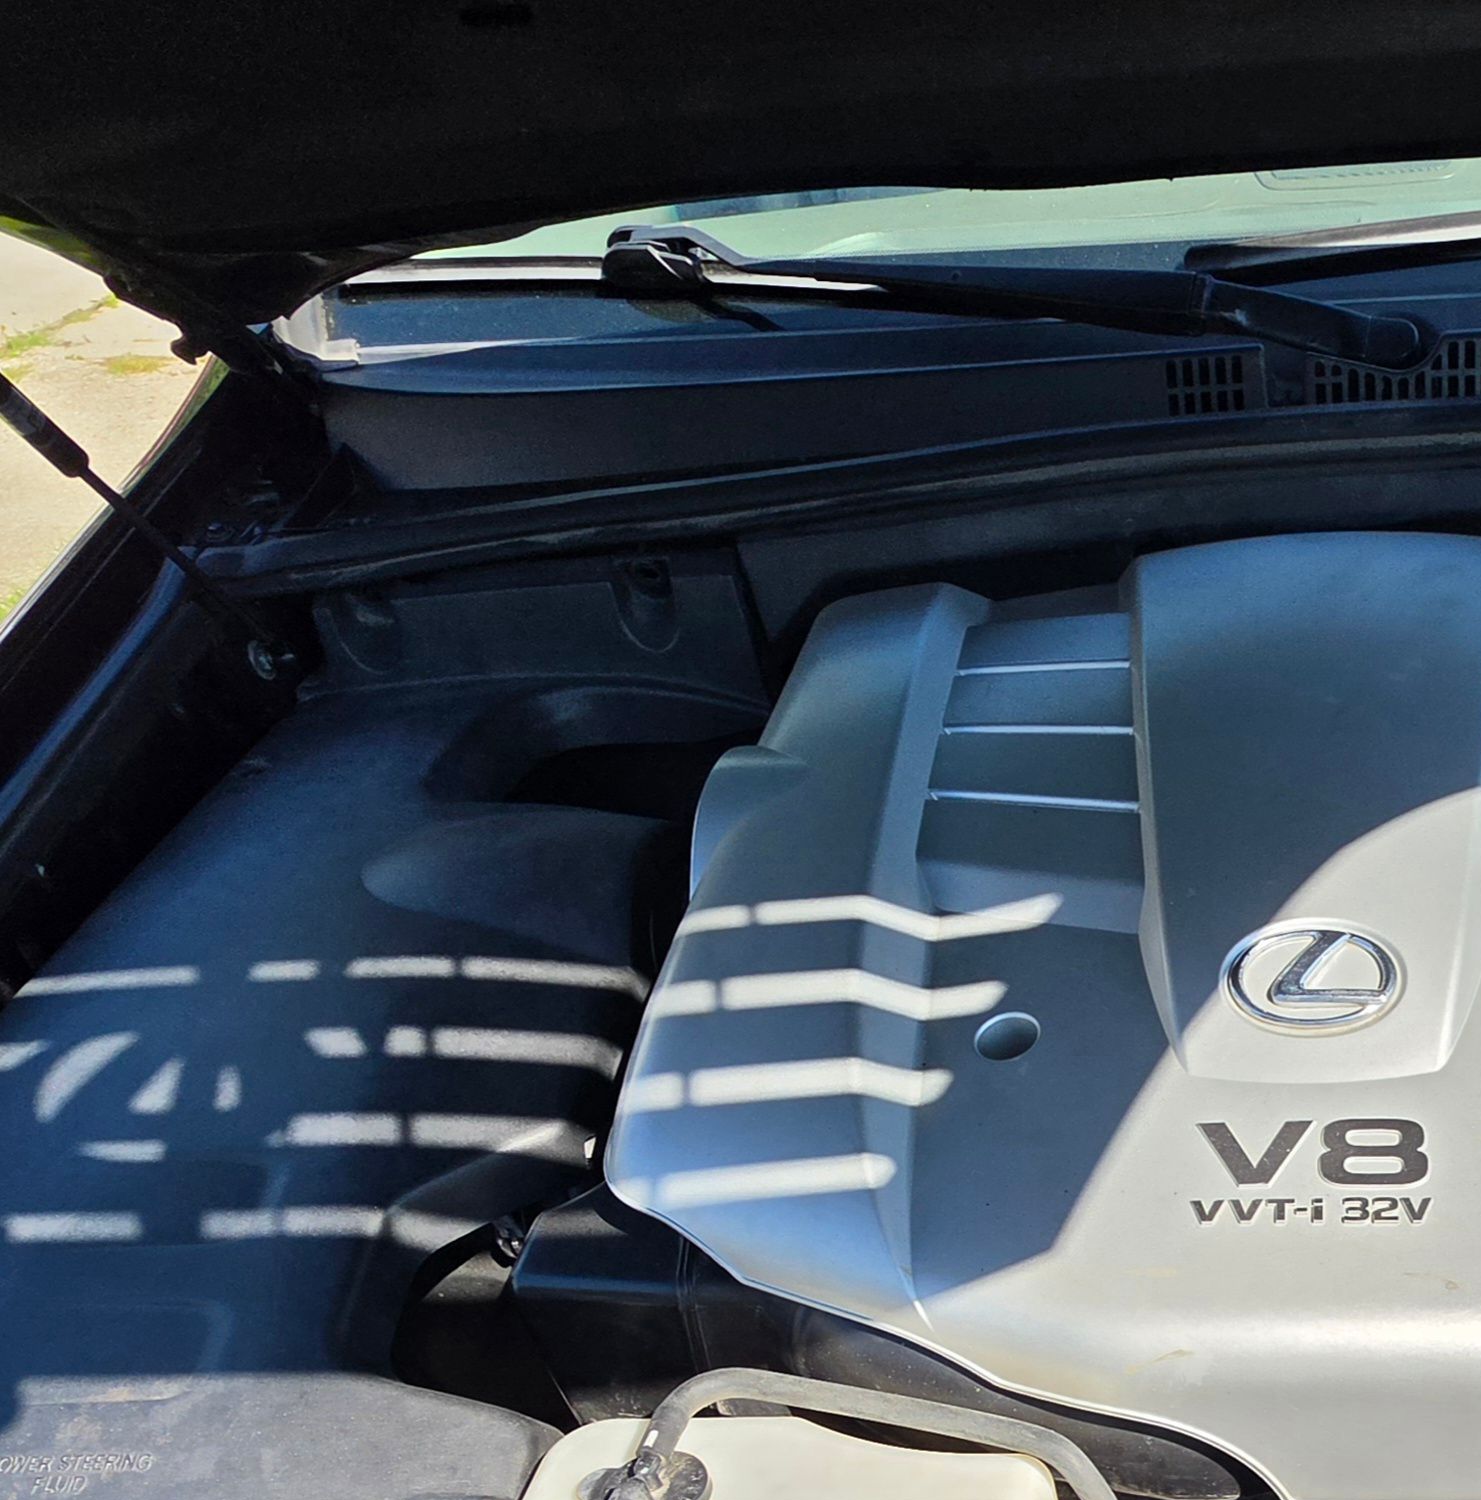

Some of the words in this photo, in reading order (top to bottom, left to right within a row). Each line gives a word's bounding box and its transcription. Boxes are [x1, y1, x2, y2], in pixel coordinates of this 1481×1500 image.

[1196, 1118, 1430, 1188] V8
[1190, 1197, 1324, 1225] VVT-i
[1341, 1197, 1432, 1225] 32V
[0, 1455, 53, 1474] OWER
[58, 1453, 154, 1473] STEERING
[30, 1475, 88, 1495] FLUID
